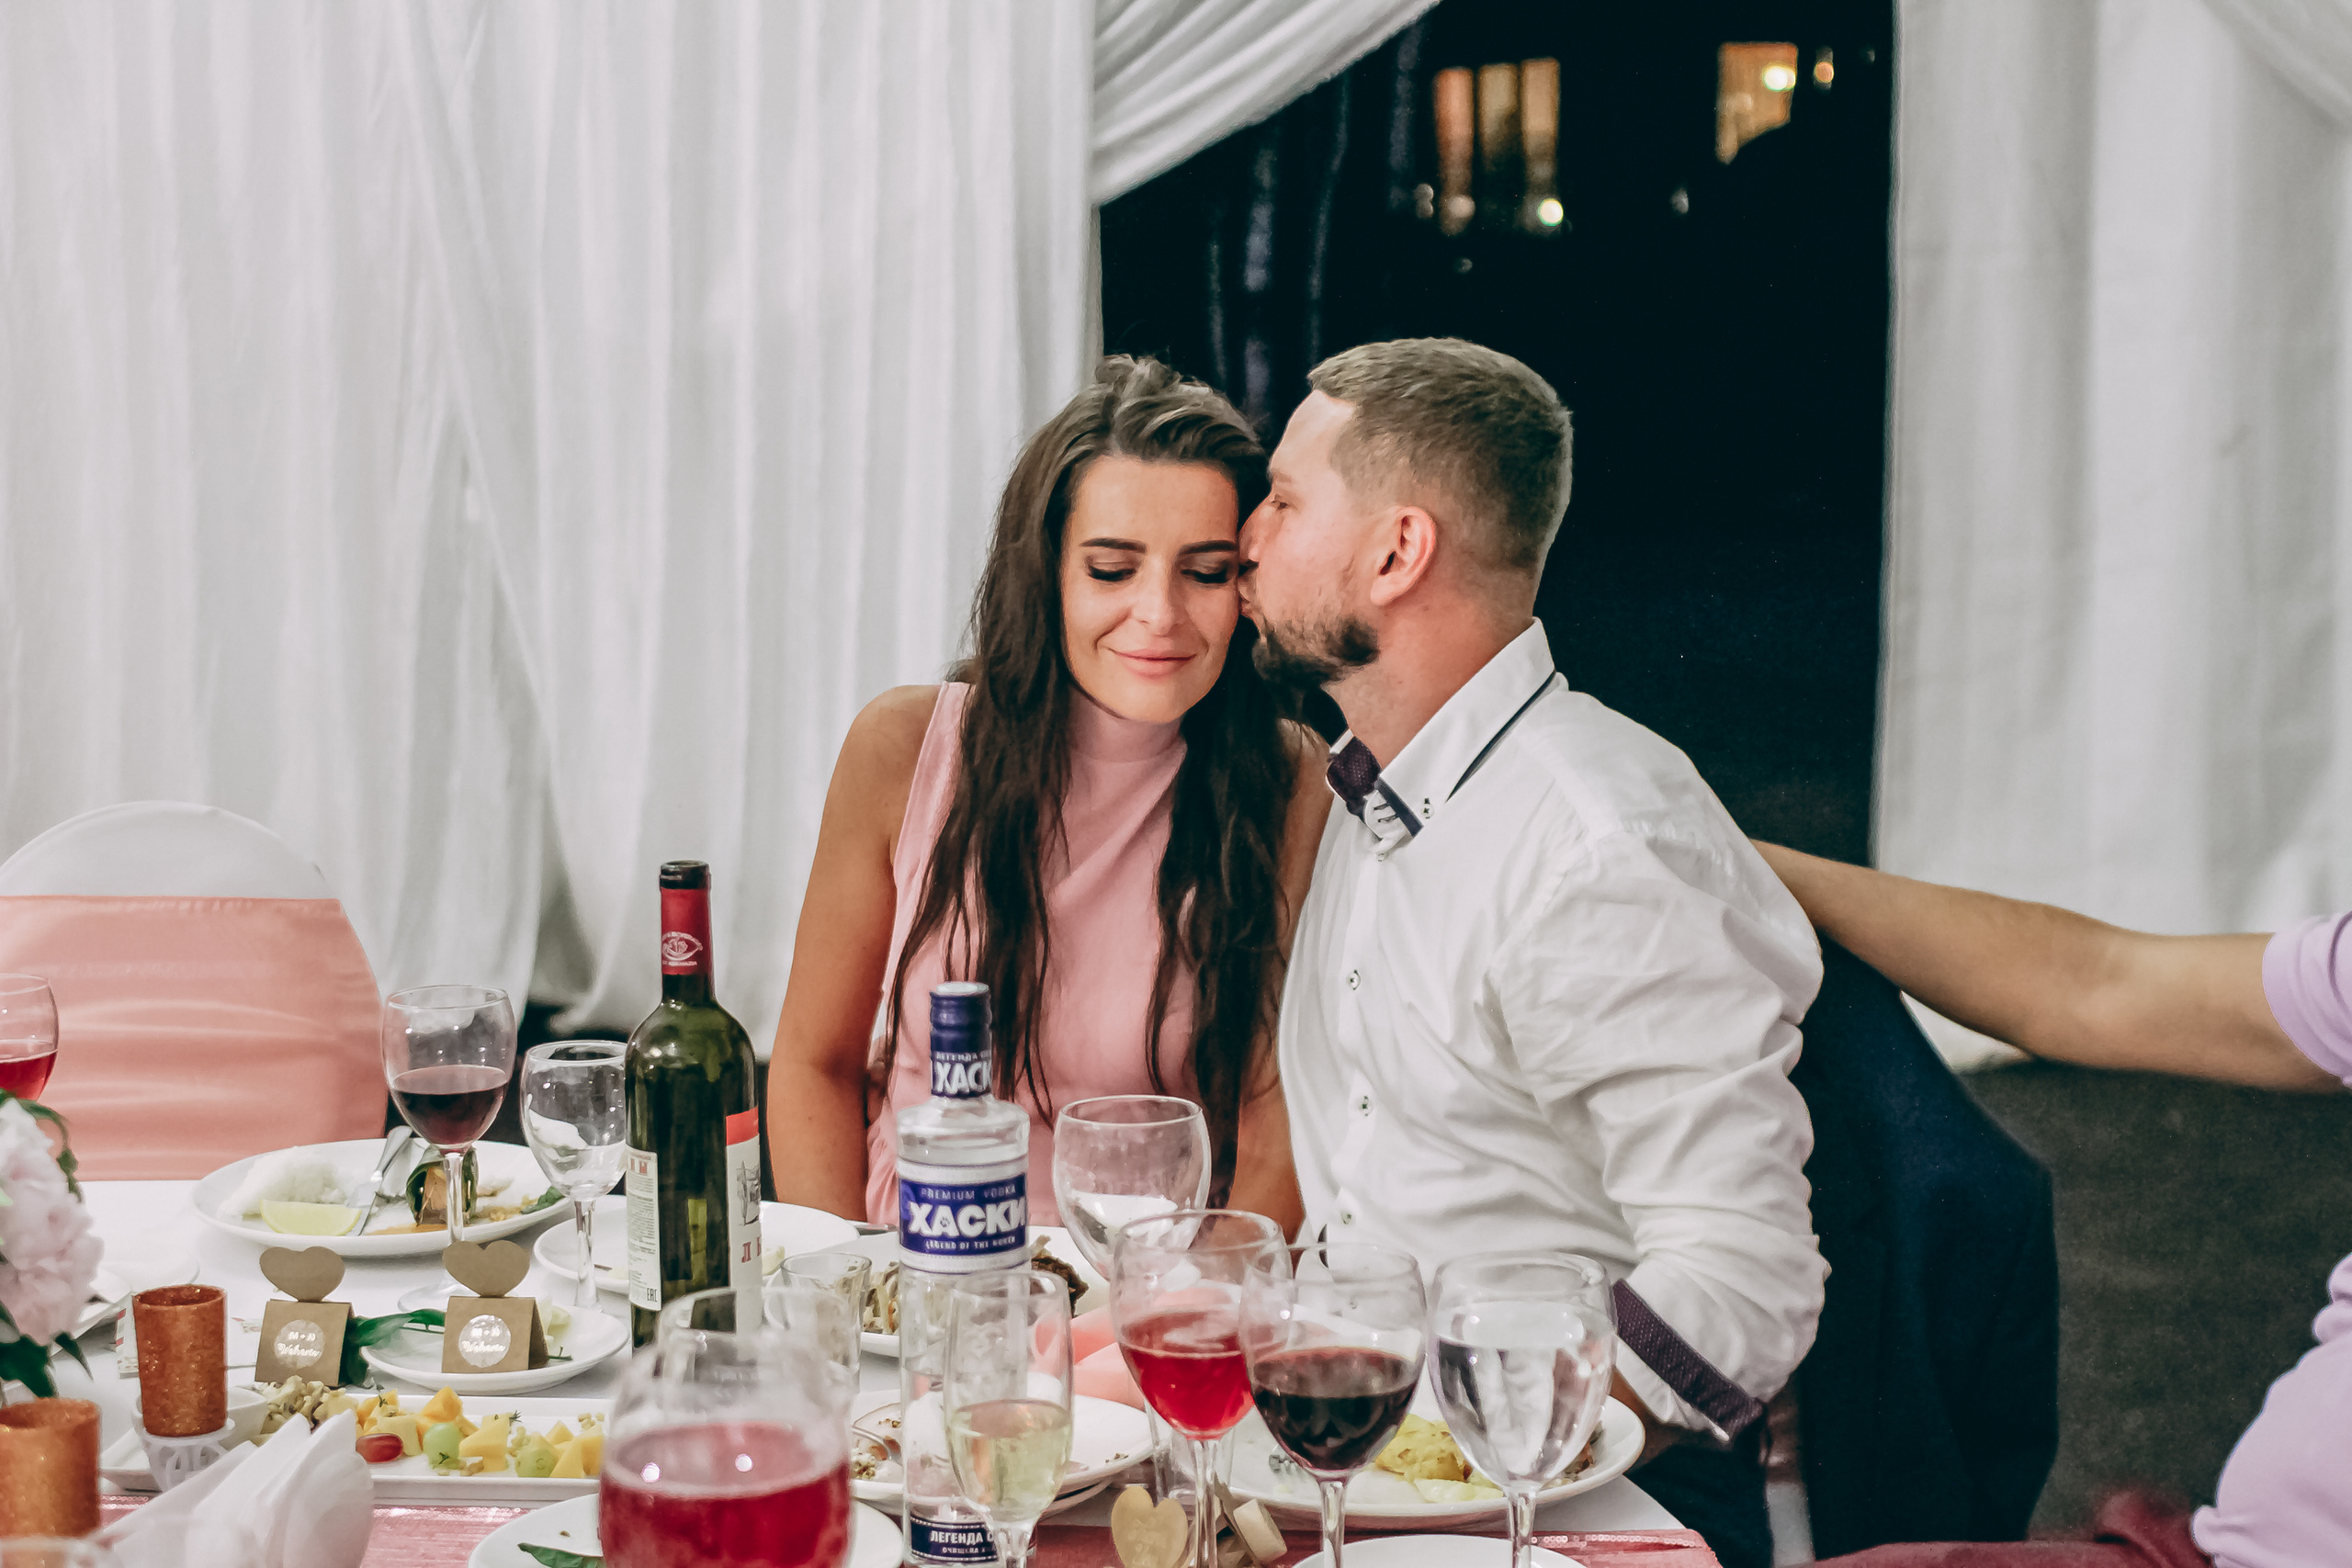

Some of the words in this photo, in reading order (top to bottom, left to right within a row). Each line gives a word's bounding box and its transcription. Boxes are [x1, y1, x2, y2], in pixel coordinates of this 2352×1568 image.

[921, 1188, 975, 1201] PREMIUM
[983, 1184, 1016, 1198] VODKA
[908, 1196, 1026, 1237] ХАСКИ
[930, 1530, 984, 1545] ЛЕГЕНДА
